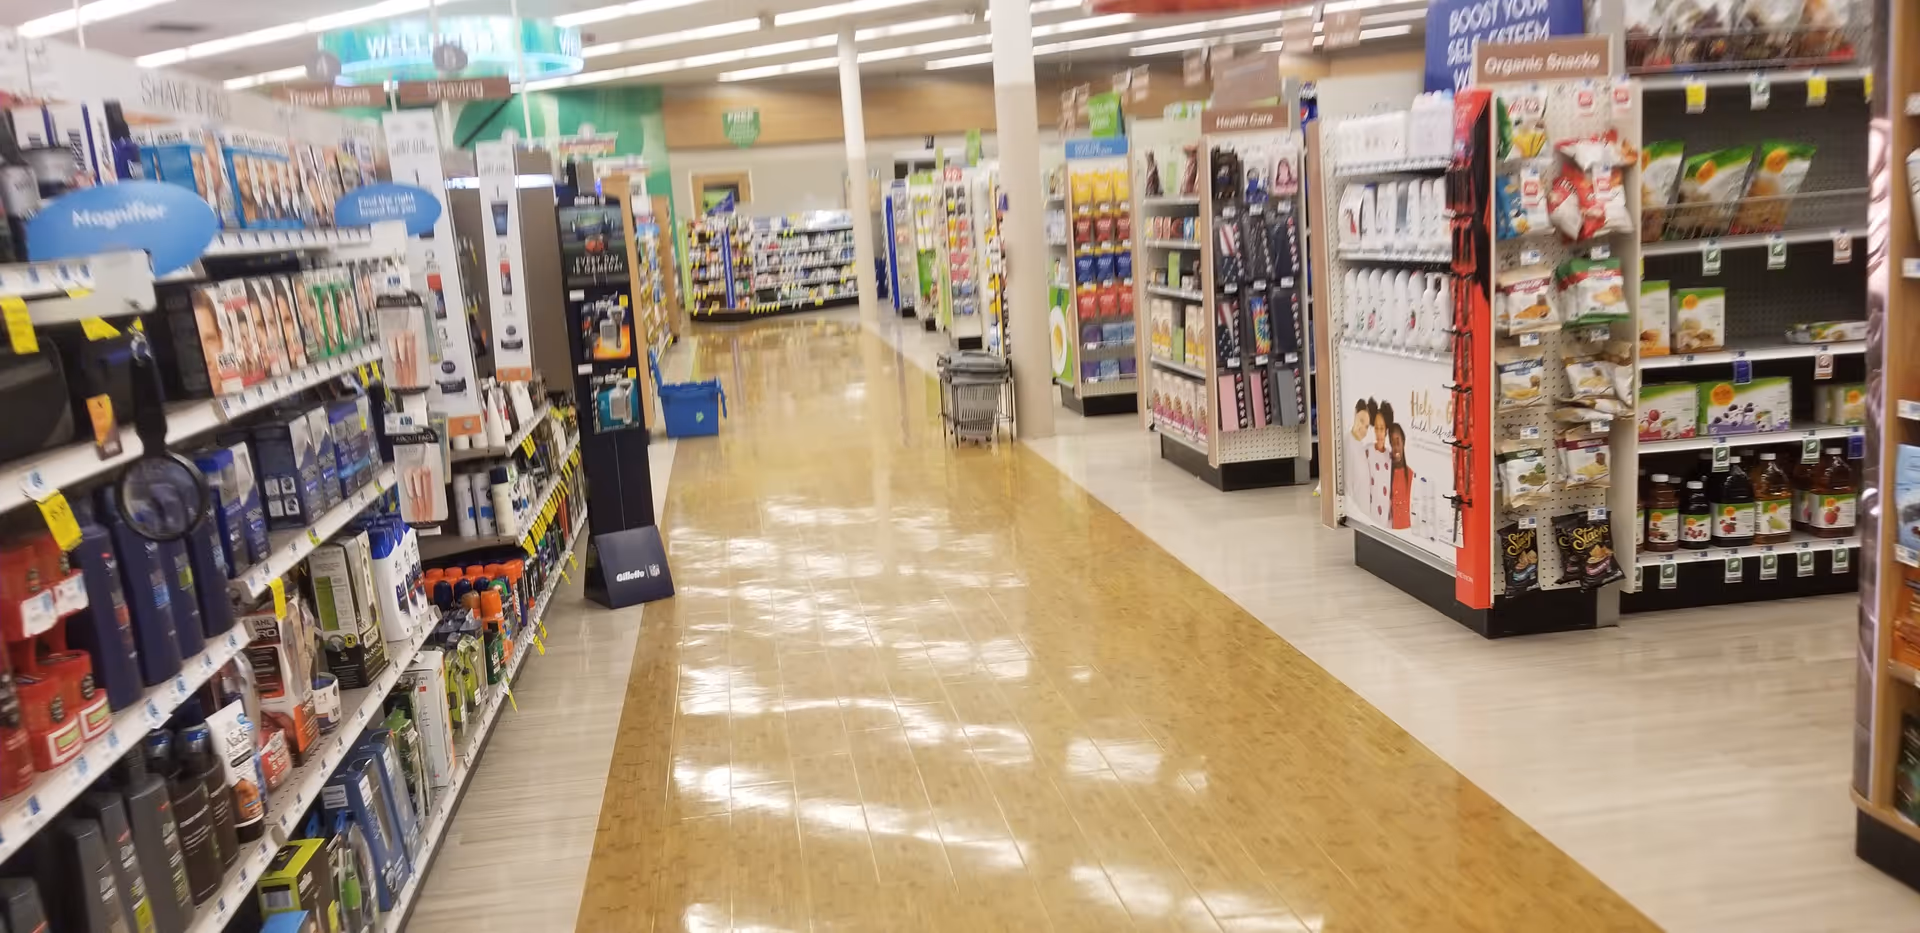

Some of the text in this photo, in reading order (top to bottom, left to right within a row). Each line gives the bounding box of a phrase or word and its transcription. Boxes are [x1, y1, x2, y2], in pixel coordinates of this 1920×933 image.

[1449, 0, 1549, 37] BOOST YOUR
[1488, 18, 1551, 46] ESTEEM
[1484, 52, 1600, 75] Organic Snacks
[140, 72, 190, 114] SHAVE
[289, 87, 370, 106] Travel Sizes
[427, 81, 484, 99] Shaving
[1215, 111, 1274, 129] Health Care
[72, 203, 167, 229] Magnifier
[1410, 389, 1432, 430] Help
[616, 570, 645, 582] Gillette
